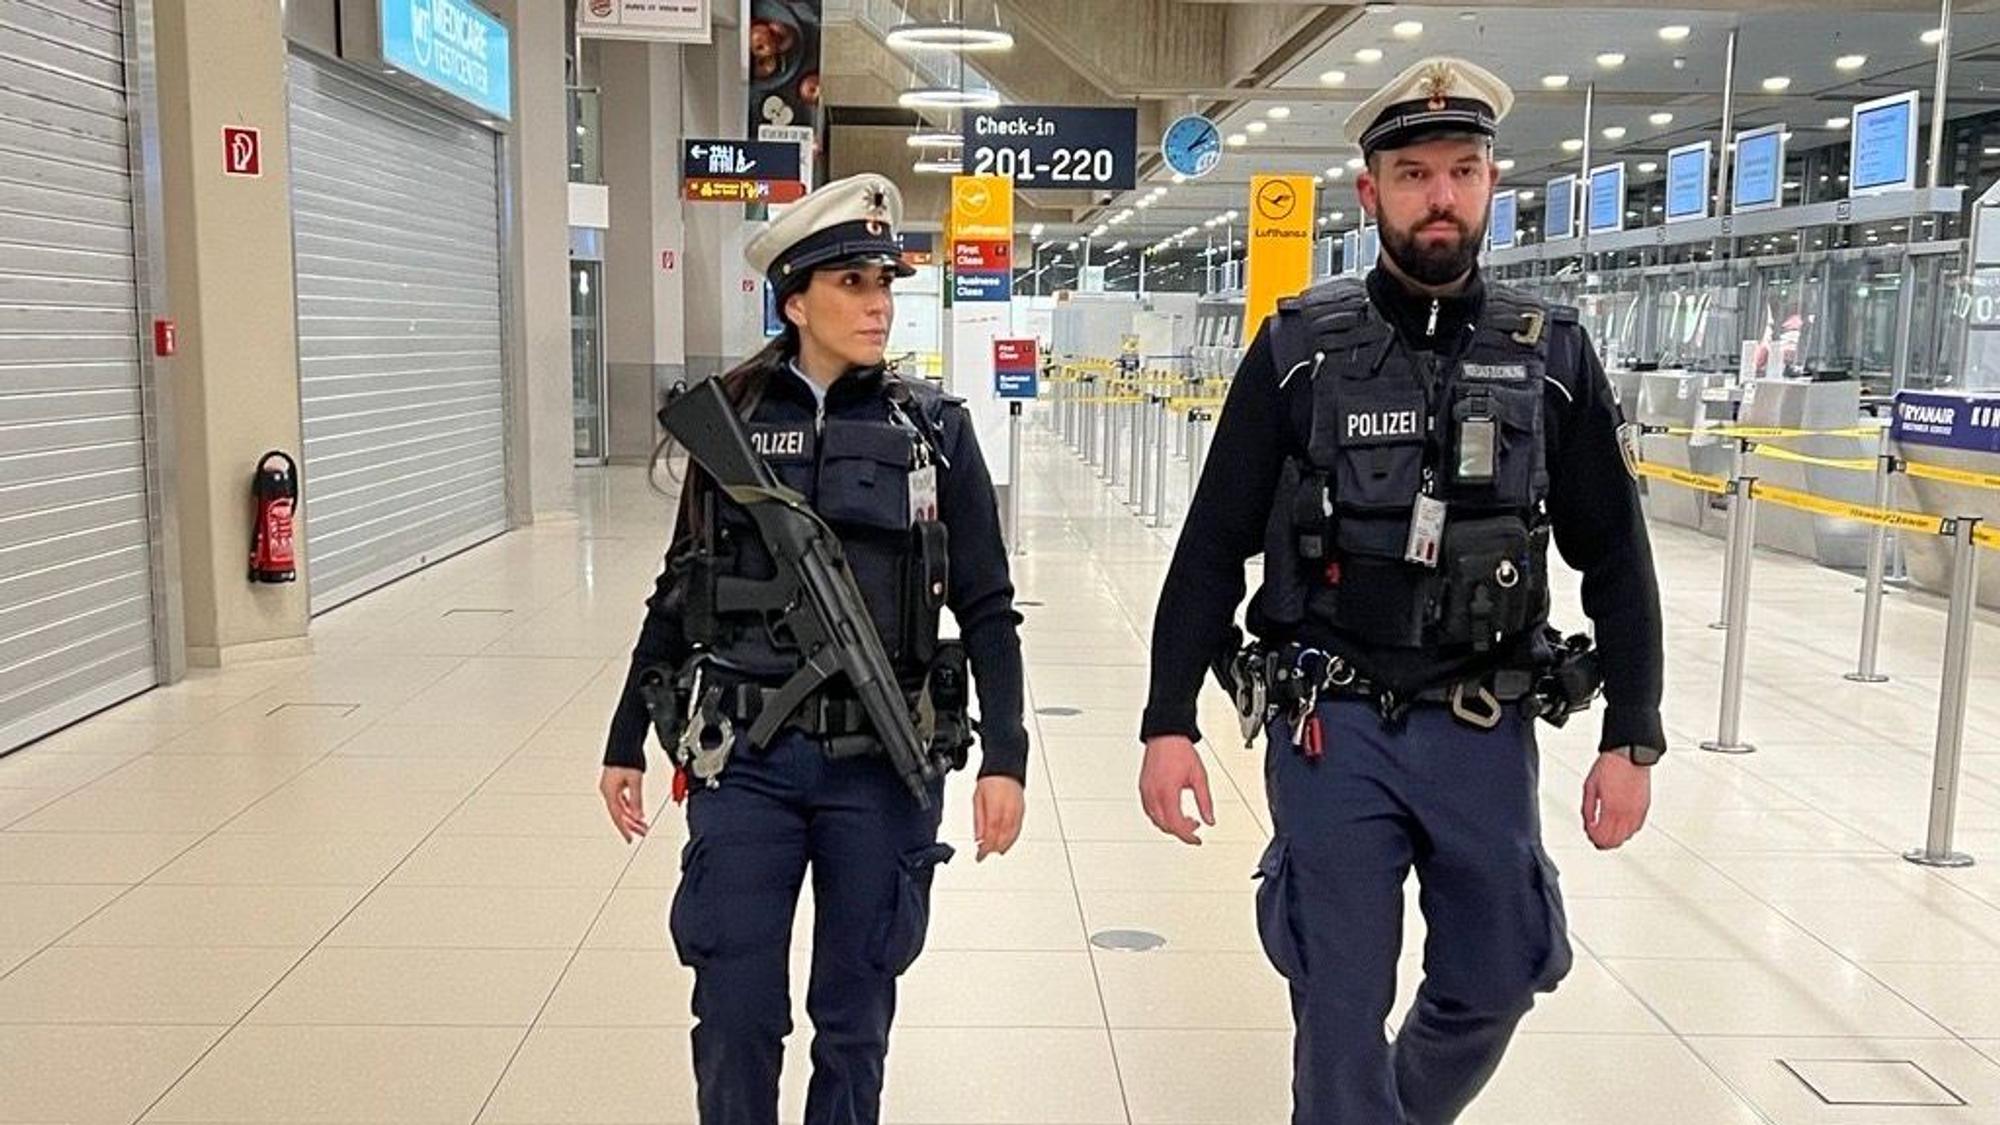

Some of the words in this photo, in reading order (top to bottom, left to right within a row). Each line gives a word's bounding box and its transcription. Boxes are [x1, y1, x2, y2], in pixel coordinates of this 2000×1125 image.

[432, 0, 488, 64] MEDICARE
[434, 38, 488, 95] TESTCENTER
[975, 115, 1055, 136] Check-in
[974, 147, 1113, 181] 201-220
[1255, 228, 1308, 238] Lufthansa
[957, 244, 980, 256] First
[957, 256, 985, 266] Class
[957, 275, 1001, 287] Business
[957, 287, 985, 297] Class
[1347, 411, 1417, 437] POLIZEI
[1904, 405, 1954, 424] RYANAIR
[751, 431, 803, 454] OLIZEI
